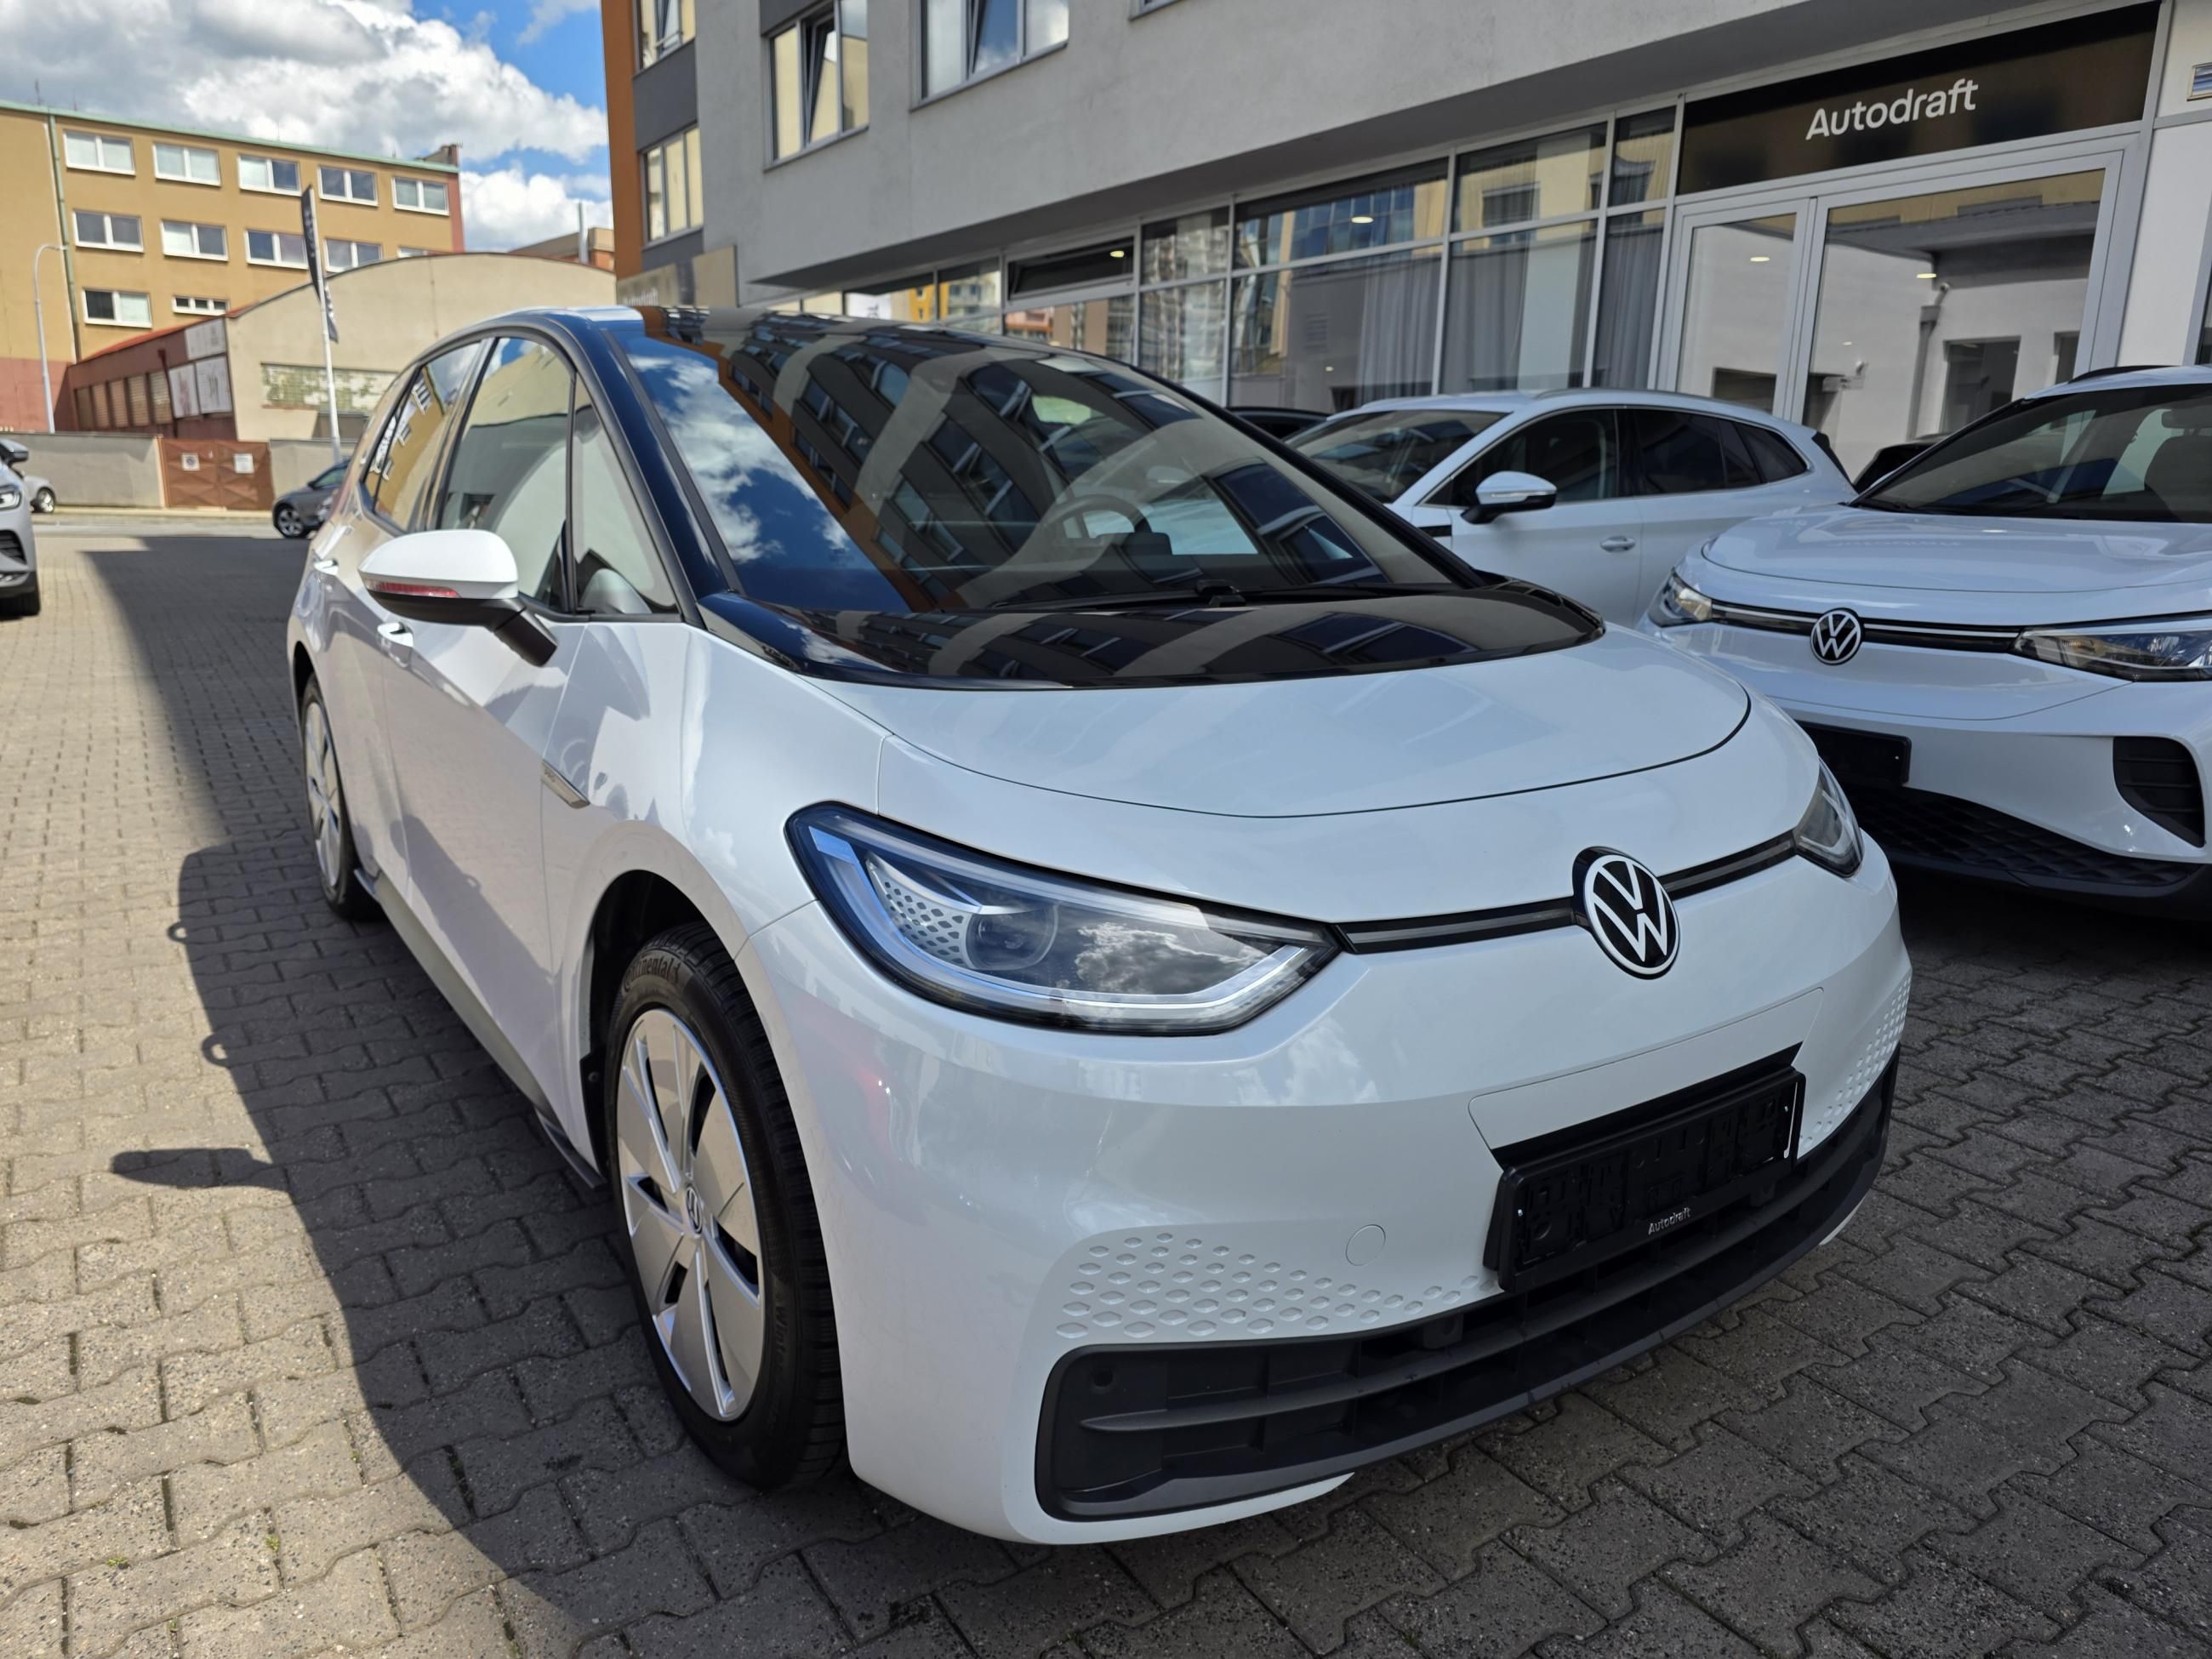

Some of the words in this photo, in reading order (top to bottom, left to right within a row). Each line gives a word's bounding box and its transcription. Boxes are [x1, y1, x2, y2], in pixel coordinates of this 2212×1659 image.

[1805, 78, 1979, 140] Autodraft
[1586, 855, 1679, 972] VW
[1647, 1206, 1691, 1236] Autodraft
